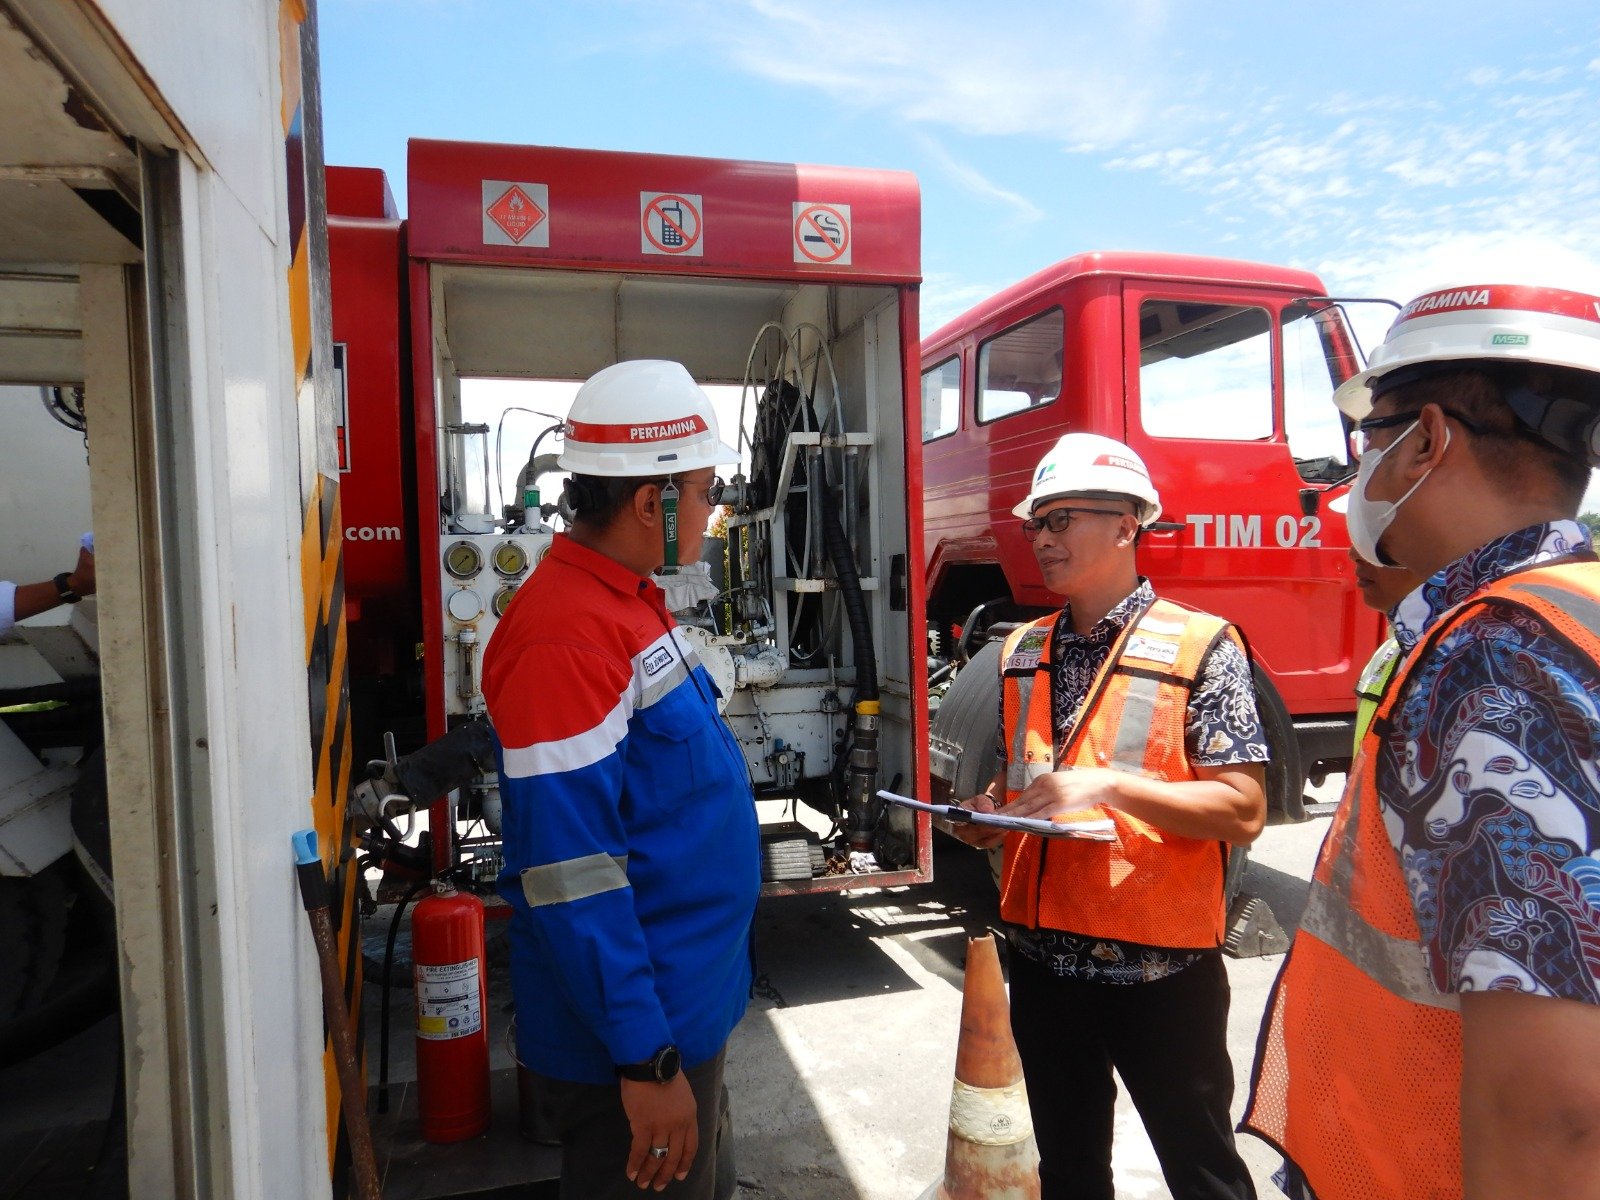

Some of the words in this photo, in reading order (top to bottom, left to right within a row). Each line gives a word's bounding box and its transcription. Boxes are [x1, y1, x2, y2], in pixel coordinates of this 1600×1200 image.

[513, 227, 519, 236] 3
[1493, 335, 1527, 345] MSA
[630, 420, 697, 439] PERTAMINA
[667, 515, 676, 539] MSA
[1186, 514, 1262, 548] TIM
[1276, 515, 1322, 548] 02
